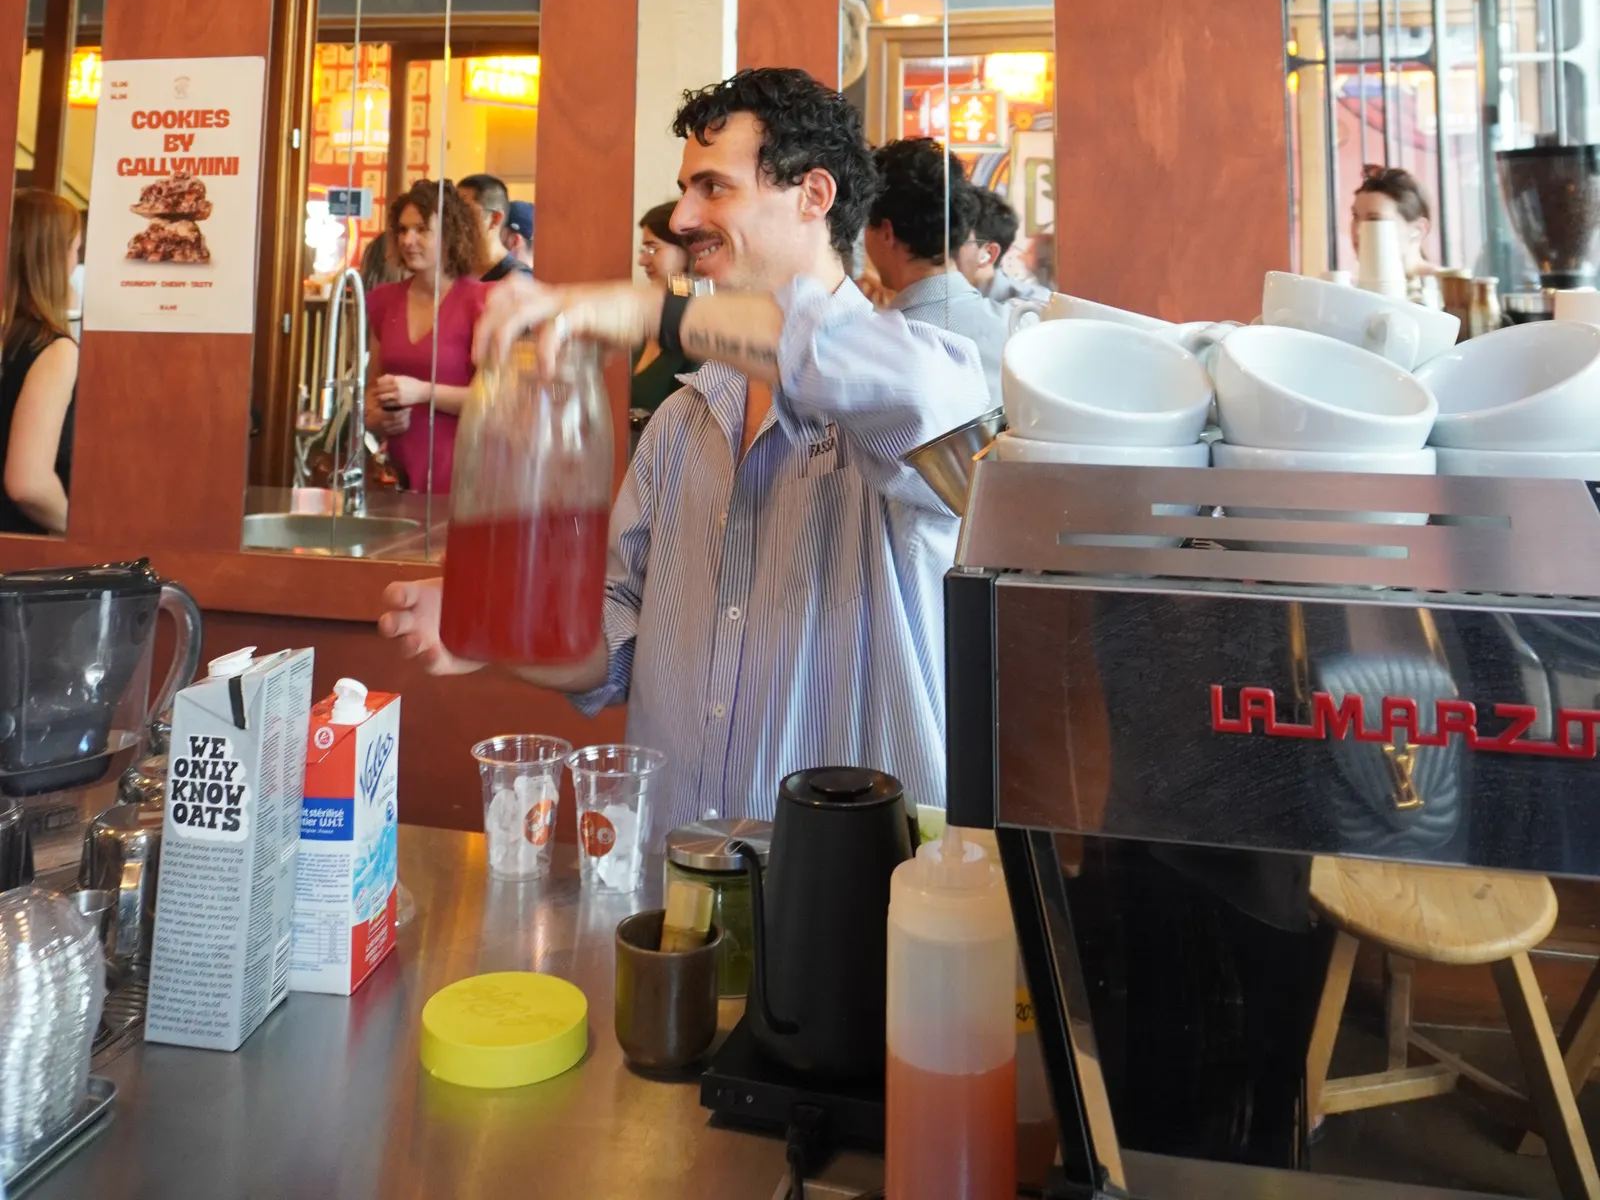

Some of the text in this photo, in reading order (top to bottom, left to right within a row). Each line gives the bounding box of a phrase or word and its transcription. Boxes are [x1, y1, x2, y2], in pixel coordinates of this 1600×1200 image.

[131, 108, 231, 130] COOKIES
[163, 133, 196, 153] BY
[116, 156, 240, 177] CALLYMINI
[1210, 684, 1275, 736] LA
[189, 735, 226, 759] WE
[174, 758, 239, 782] ONLY
[171, 780, 245, 806] KNOW
[173, 803, 241, 832] OATS
[308, 808, 345, 818] stérilisé
[318, 818, 345, 828] U.H.T.
